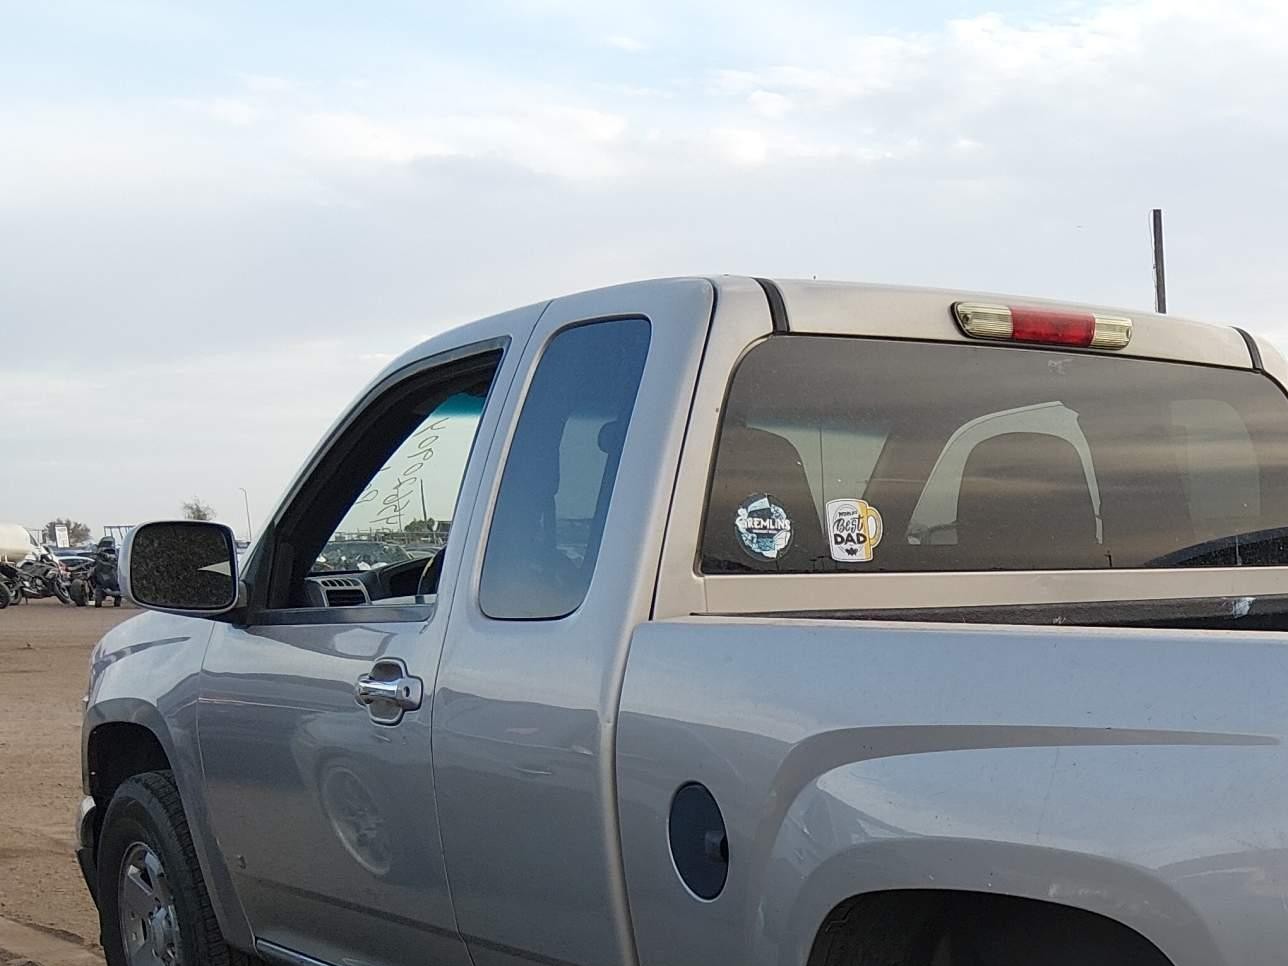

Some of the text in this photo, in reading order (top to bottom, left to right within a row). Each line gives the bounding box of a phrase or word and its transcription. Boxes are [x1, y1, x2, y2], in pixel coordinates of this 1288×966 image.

[736, 516, 791, 530] GREMLINS
[833, 514, 864, 533] Best
[834, 532, 867, 545] DAD
